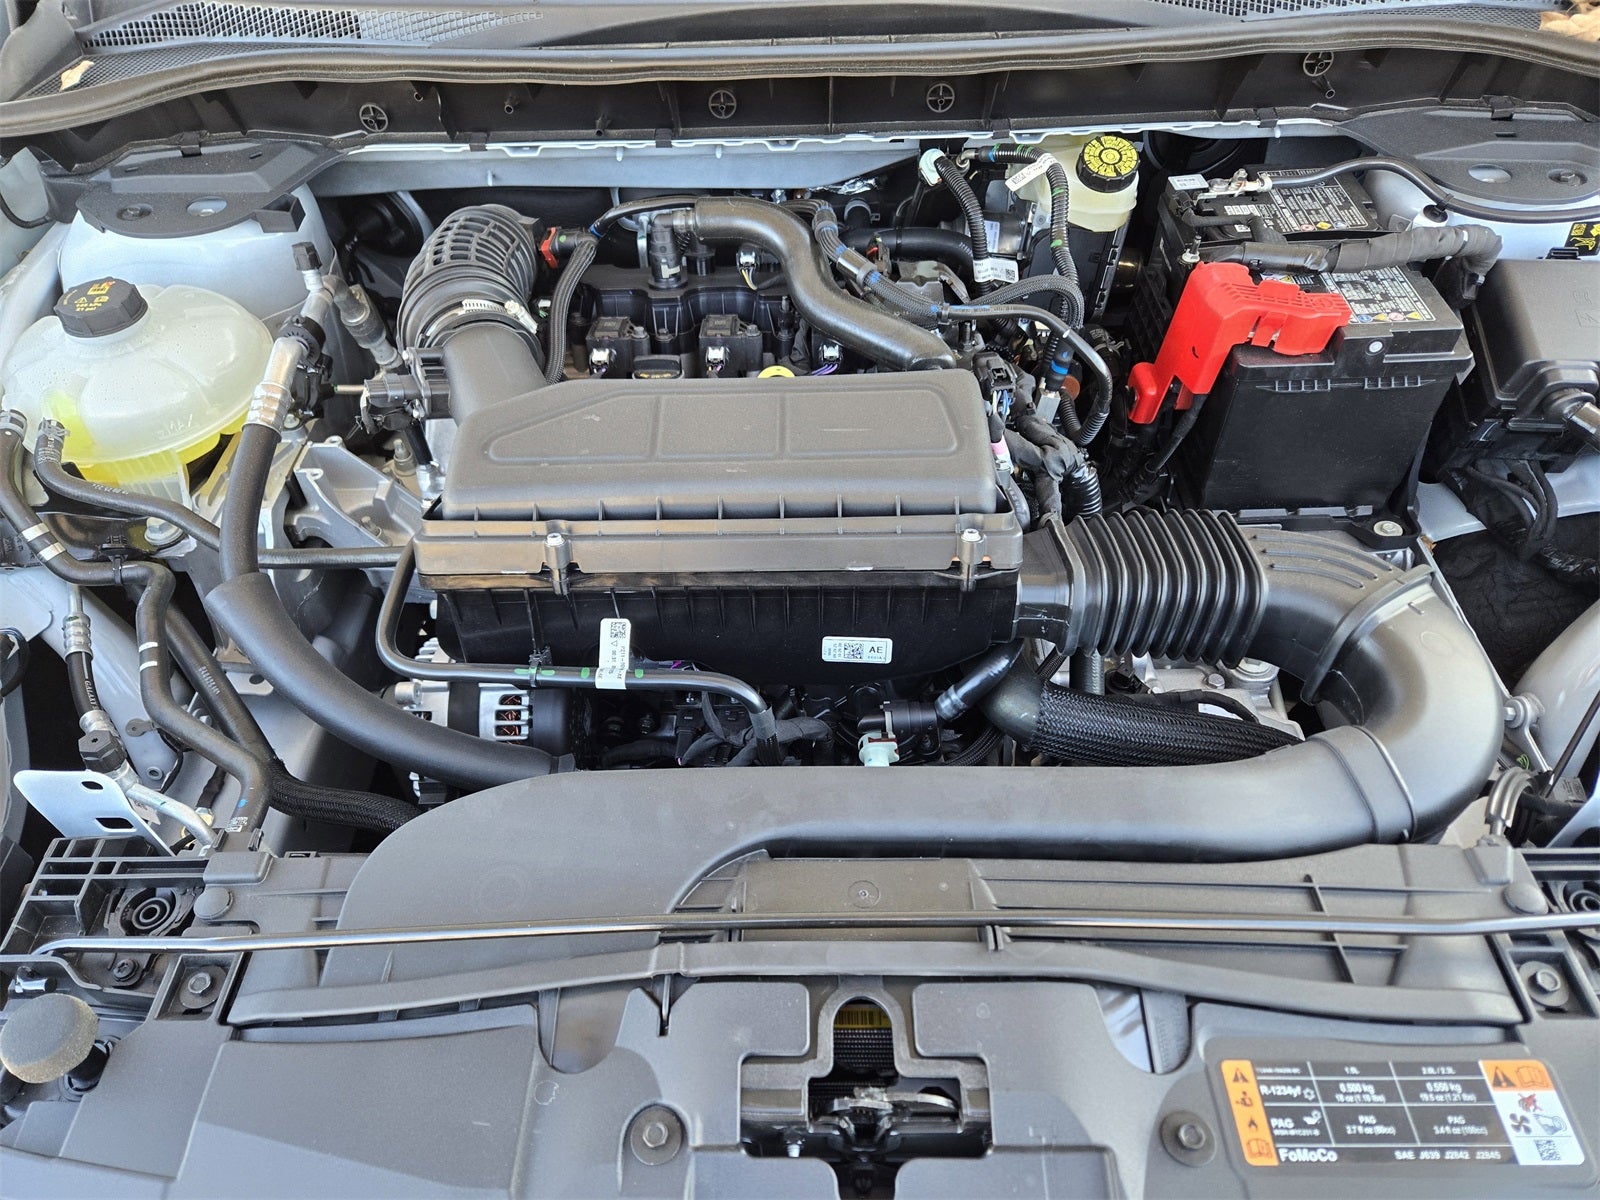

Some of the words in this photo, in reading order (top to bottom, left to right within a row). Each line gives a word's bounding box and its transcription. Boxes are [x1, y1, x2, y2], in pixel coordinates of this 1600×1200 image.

[869, 646, 884, 654] AE
[1259, 1084, 1302, 1098] R-1234yf
[1362, 1083, 1376, 1095] kg
[1449, 1082, 1463, 1094] kg
[1270, 1117, 1295, 1129] PAG
[1358, 1114, 1377, 1124] PAG
[1446, 1115, 1466, 1125] PAG
[1278, 1148, 1338, 1162] FoMoCo
[1394, 1150, 1416, 1160] SAE
